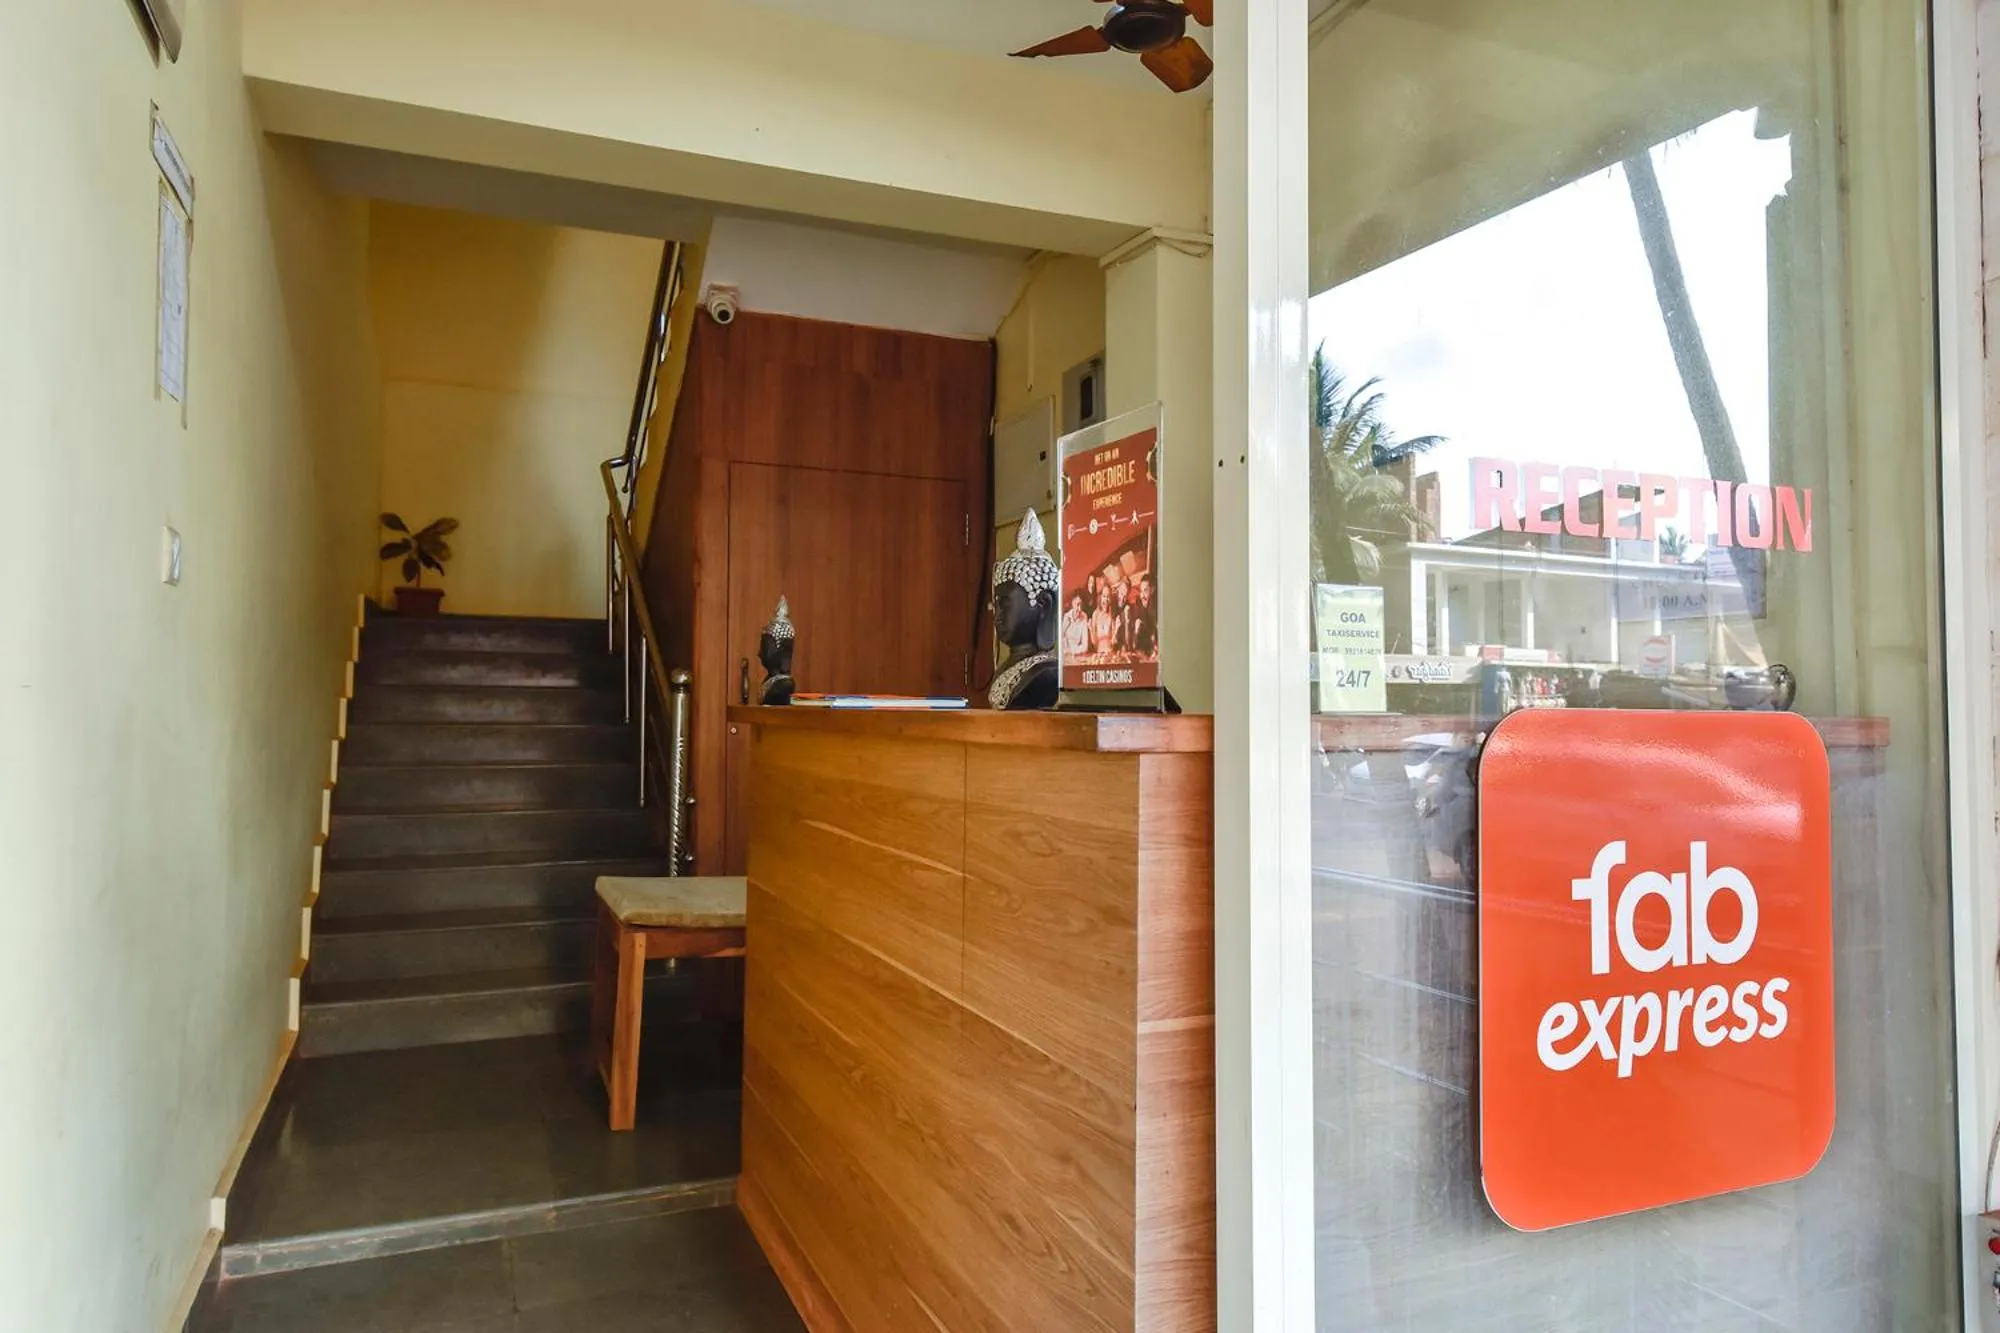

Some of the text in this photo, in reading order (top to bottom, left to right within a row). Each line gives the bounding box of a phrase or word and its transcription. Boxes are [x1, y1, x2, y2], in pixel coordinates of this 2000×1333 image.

[1081, 460, 1136, 496] INCREDIBLE
[1093, 492, 1122, 510] EXPERIENCE
[1470, 456, 1813, 553] RECEPTION
[1340, 612, 1366, 624] GOA
[1327, 629, 1380, 639] TAXISERVICE
[1336, 670, 1371, 689] 24/7
[1571, 840, 1759, 975] fab
[1536, 976, 1790, 1078] express
